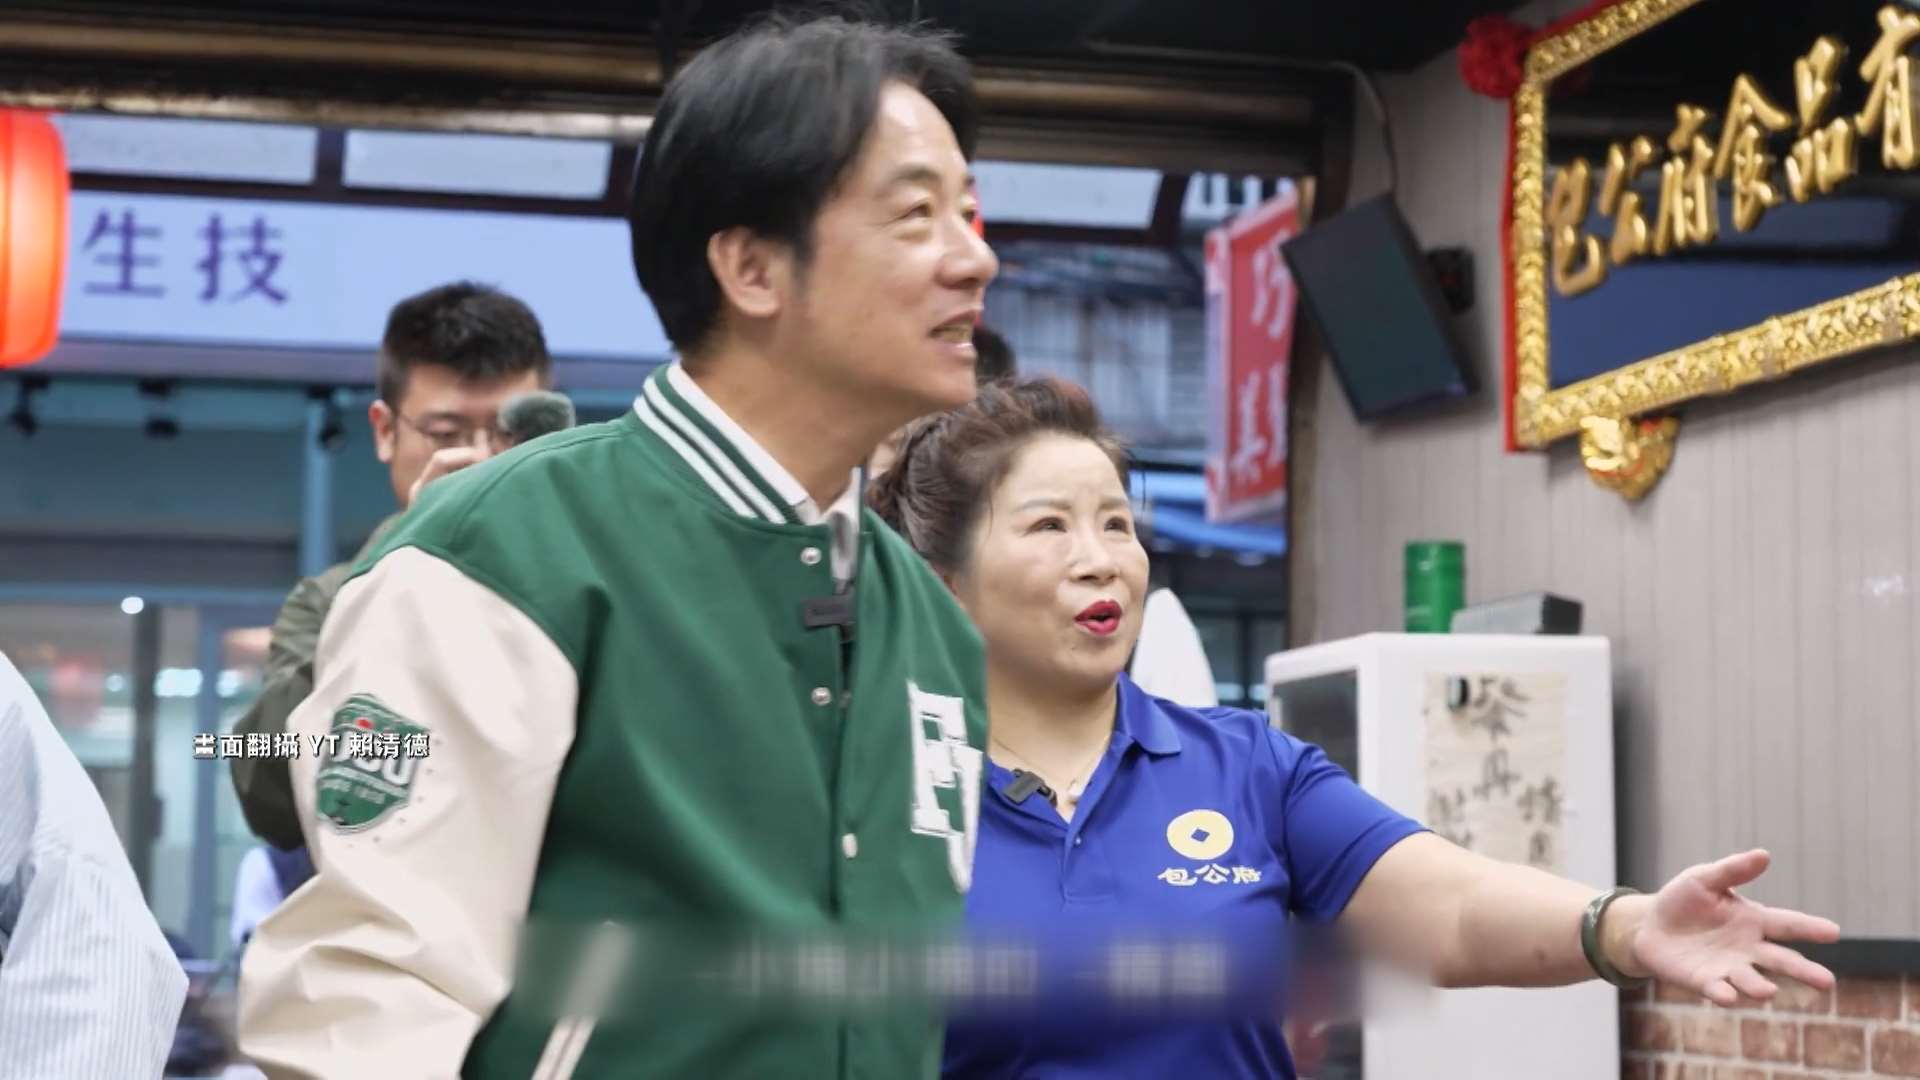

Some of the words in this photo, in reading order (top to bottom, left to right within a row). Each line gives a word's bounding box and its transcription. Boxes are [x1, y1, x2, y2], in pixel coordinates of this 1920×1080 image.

[81, 206, 289, 304] 生技
[1157, 863, 1262, 887] 包公府
